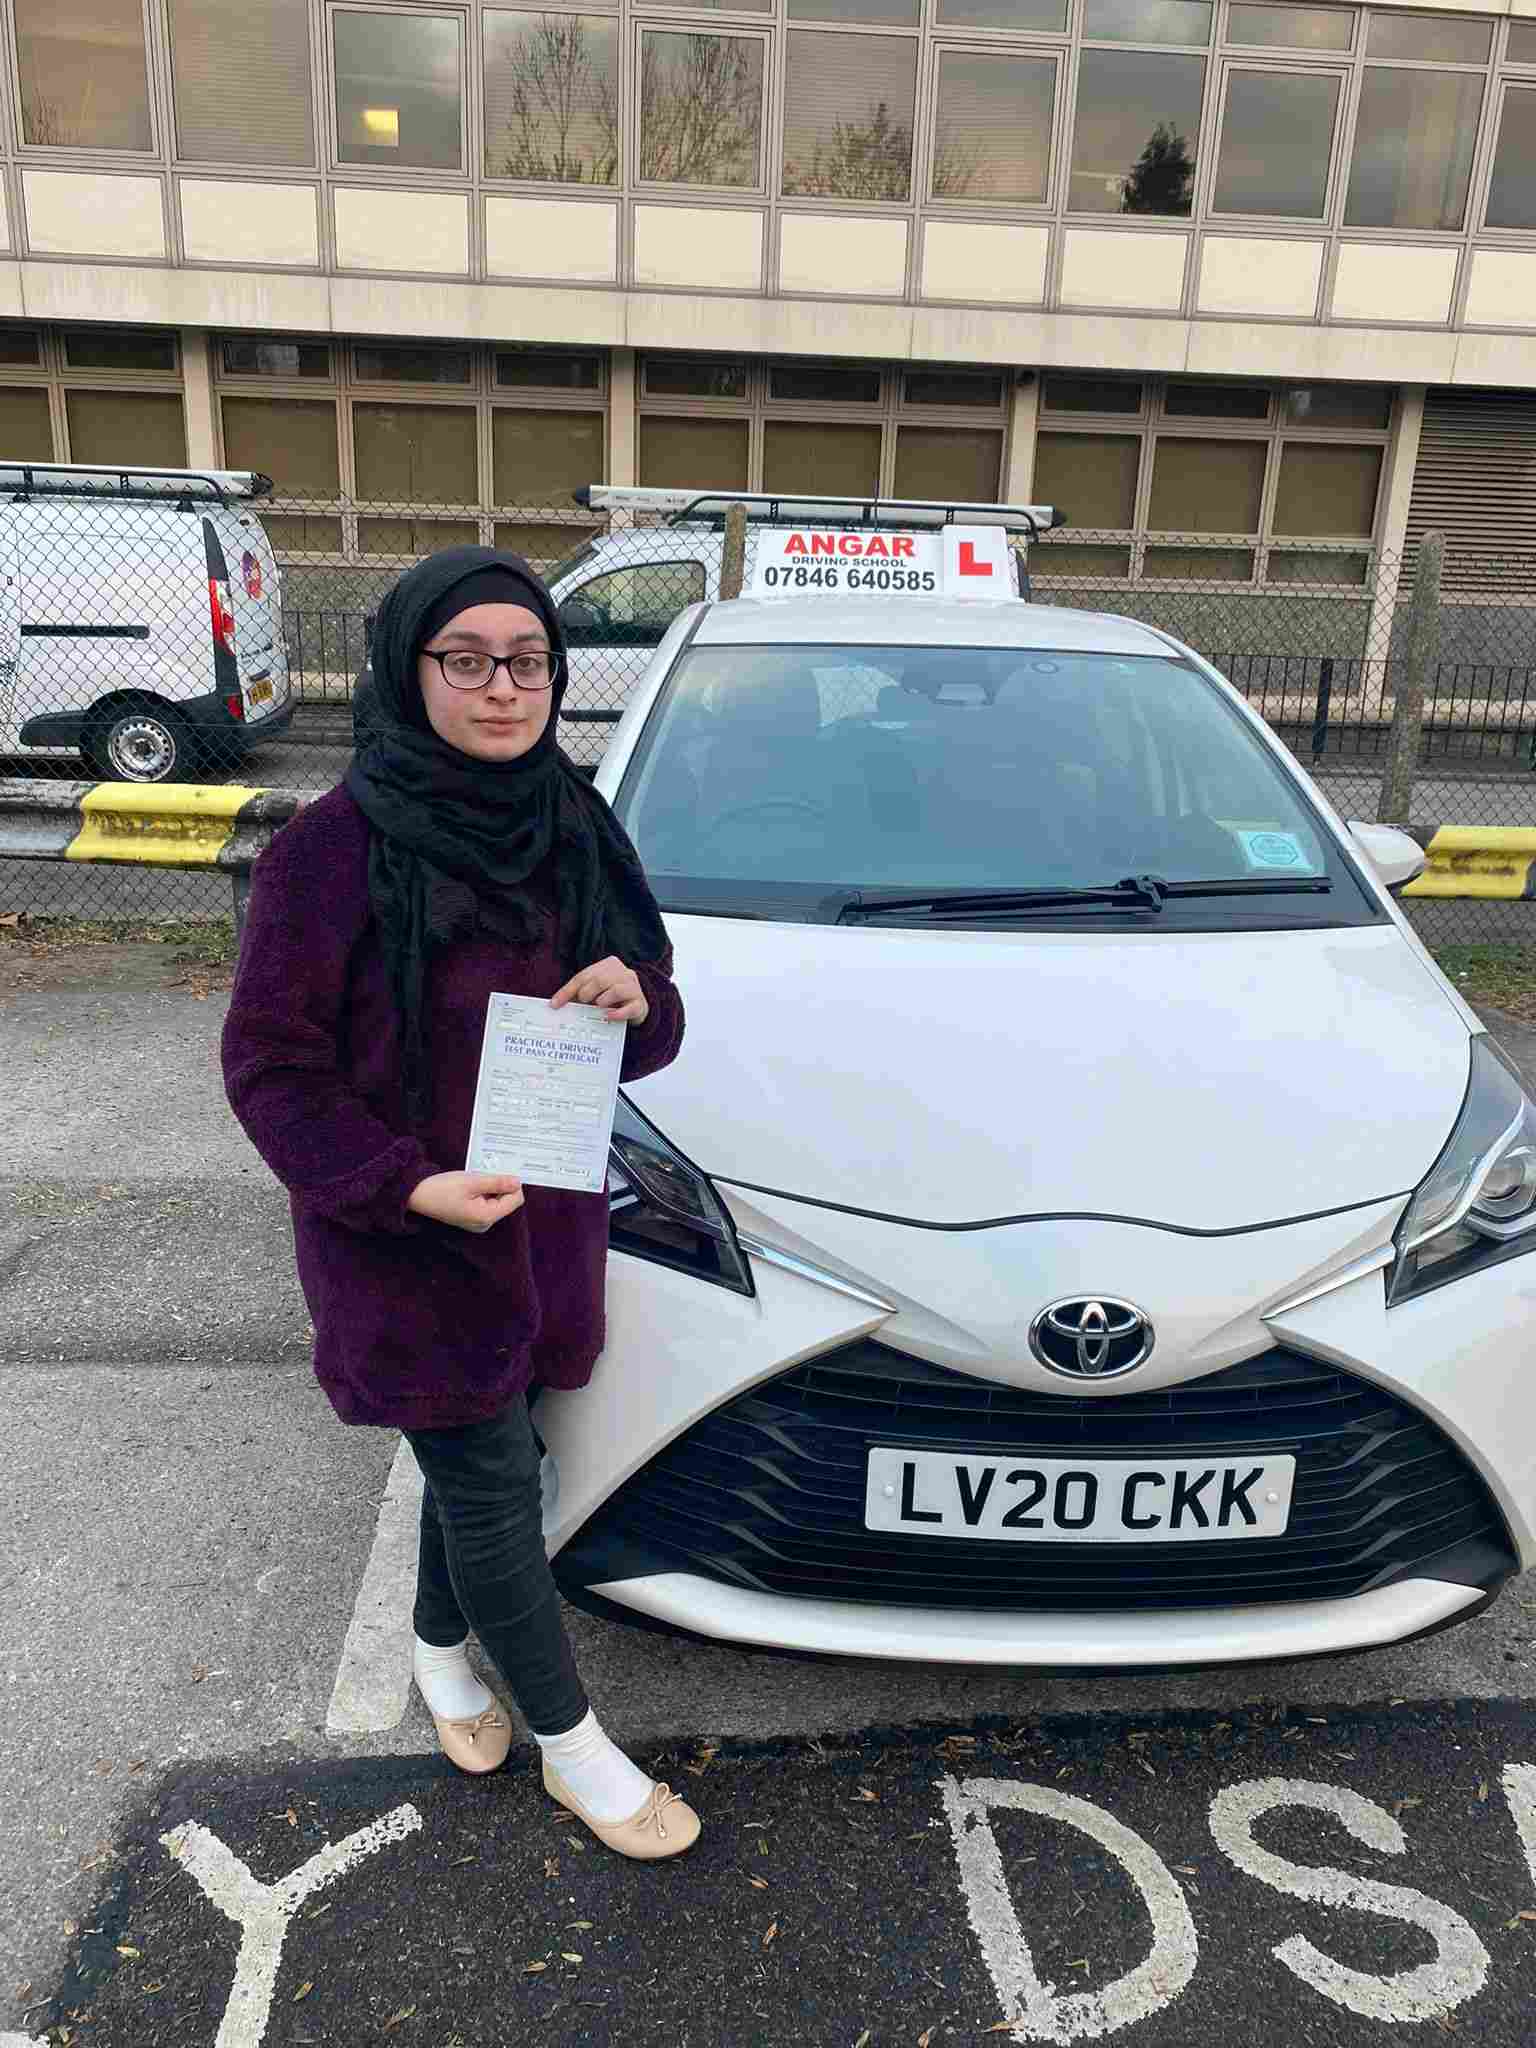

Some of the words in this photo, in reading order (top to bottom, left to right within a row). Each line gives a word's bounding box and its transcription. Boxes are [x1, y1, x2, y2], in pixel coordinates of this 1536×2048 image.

[784, 534, 915, 557] ANGAR
[958, 541, 993, 576] L
[792, 556, 848, 566] DRIVING
[852, 558, 908, 568] SCHOOL
[764, 566, 839, 588] 07846
[847, 568, 936, 592] 640585
[504, 1035, 558, 1050] PRACTICAL
[559, 1042, 603, 1056] DRIVING
[504, 1045, 524, 1056] TEST
[526, 1047, 546, 1058] PASS
[547, 1049, 600, 1065] CERTIFICATE
[900, 1462, 1099, 1530] LV20
[1120, 1466, 1265, 1530] CKK
[935, 1763, 1536, 2047] DS
[159, 1802, 424, 2048] Y
